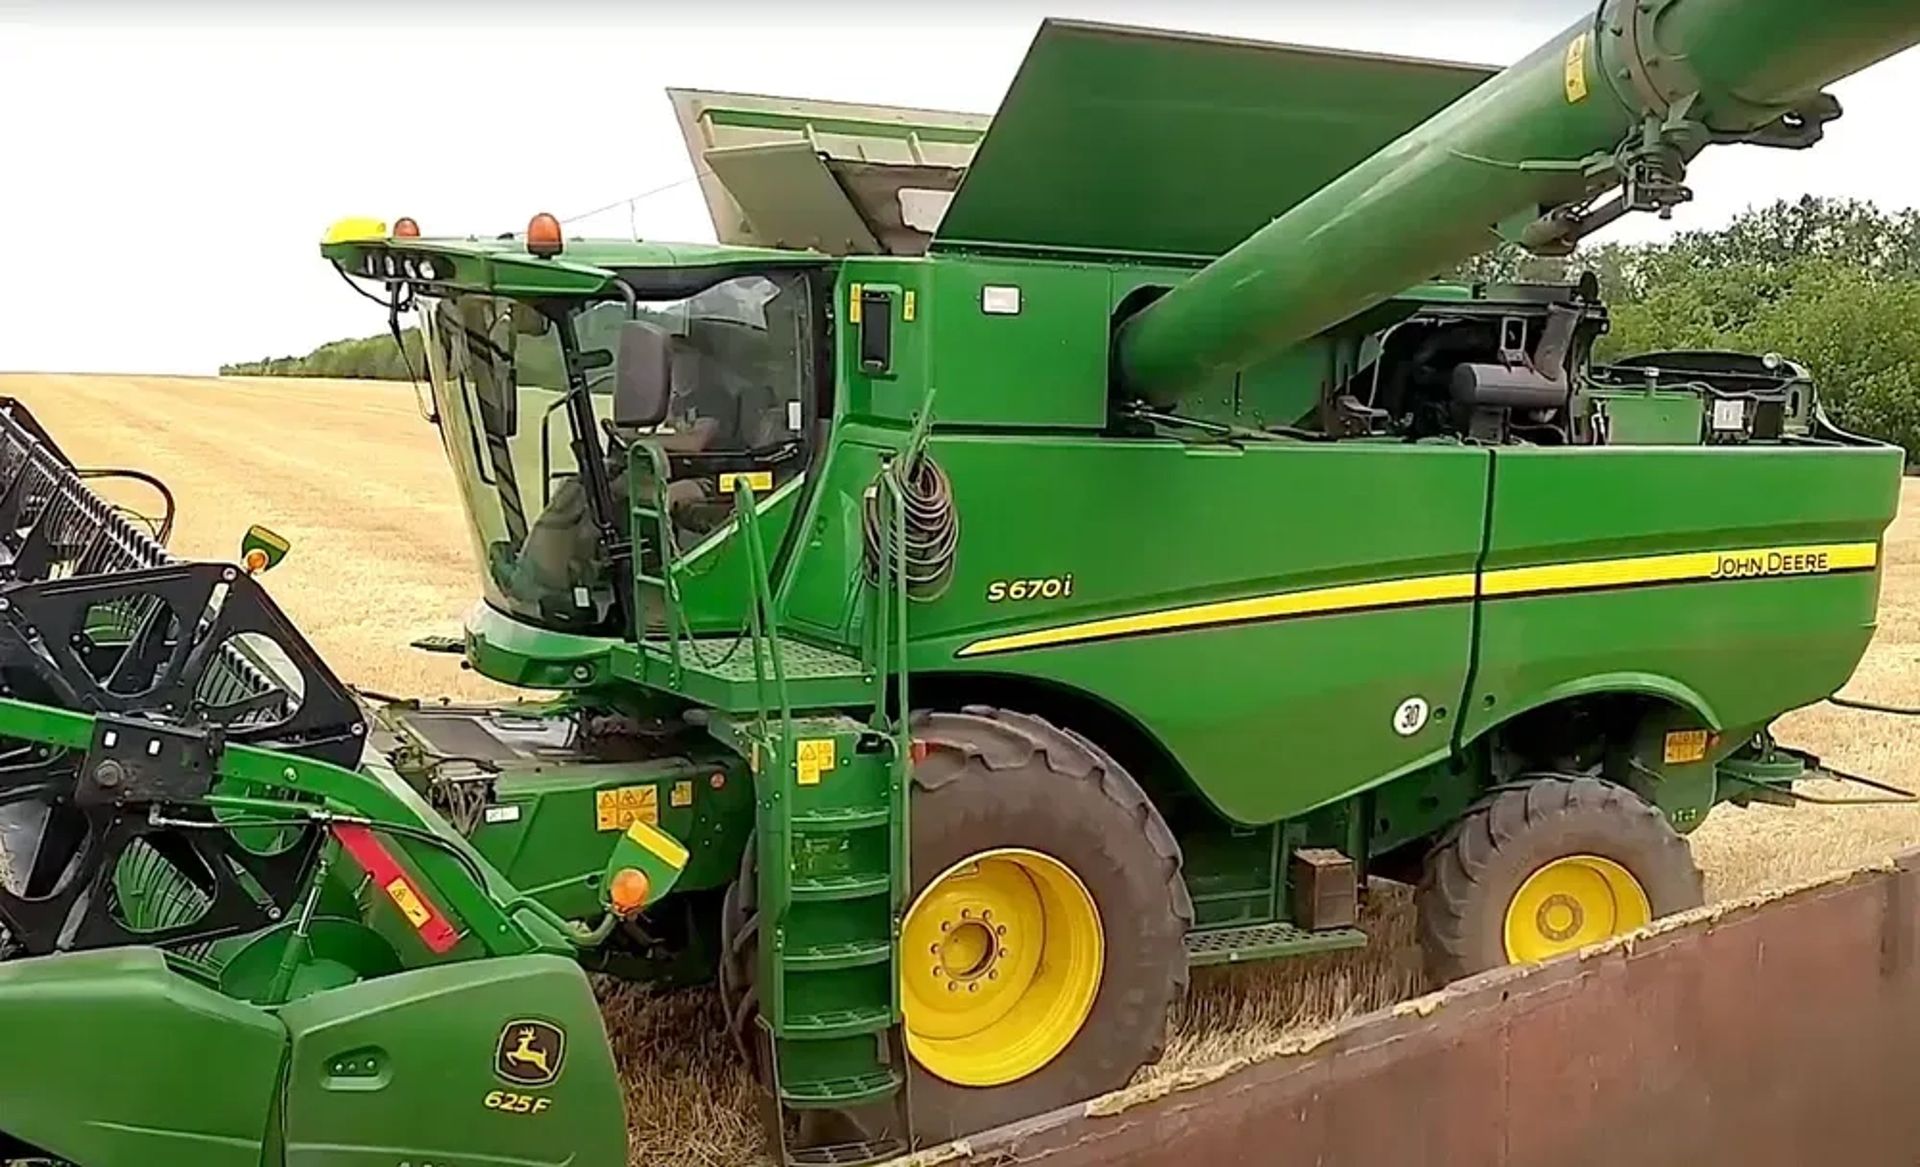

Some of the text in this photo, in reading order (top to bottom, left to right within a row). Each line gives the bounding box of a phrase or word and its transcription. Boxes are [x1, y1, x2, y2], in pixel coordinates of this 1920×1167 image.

[1711, 552, 1829, 576] JOHN DEERE
[987, 573, 1073, 601] S670i
[1401, 703, 1420, 729] 30
[484, 1090, 552, 1114] 625F
